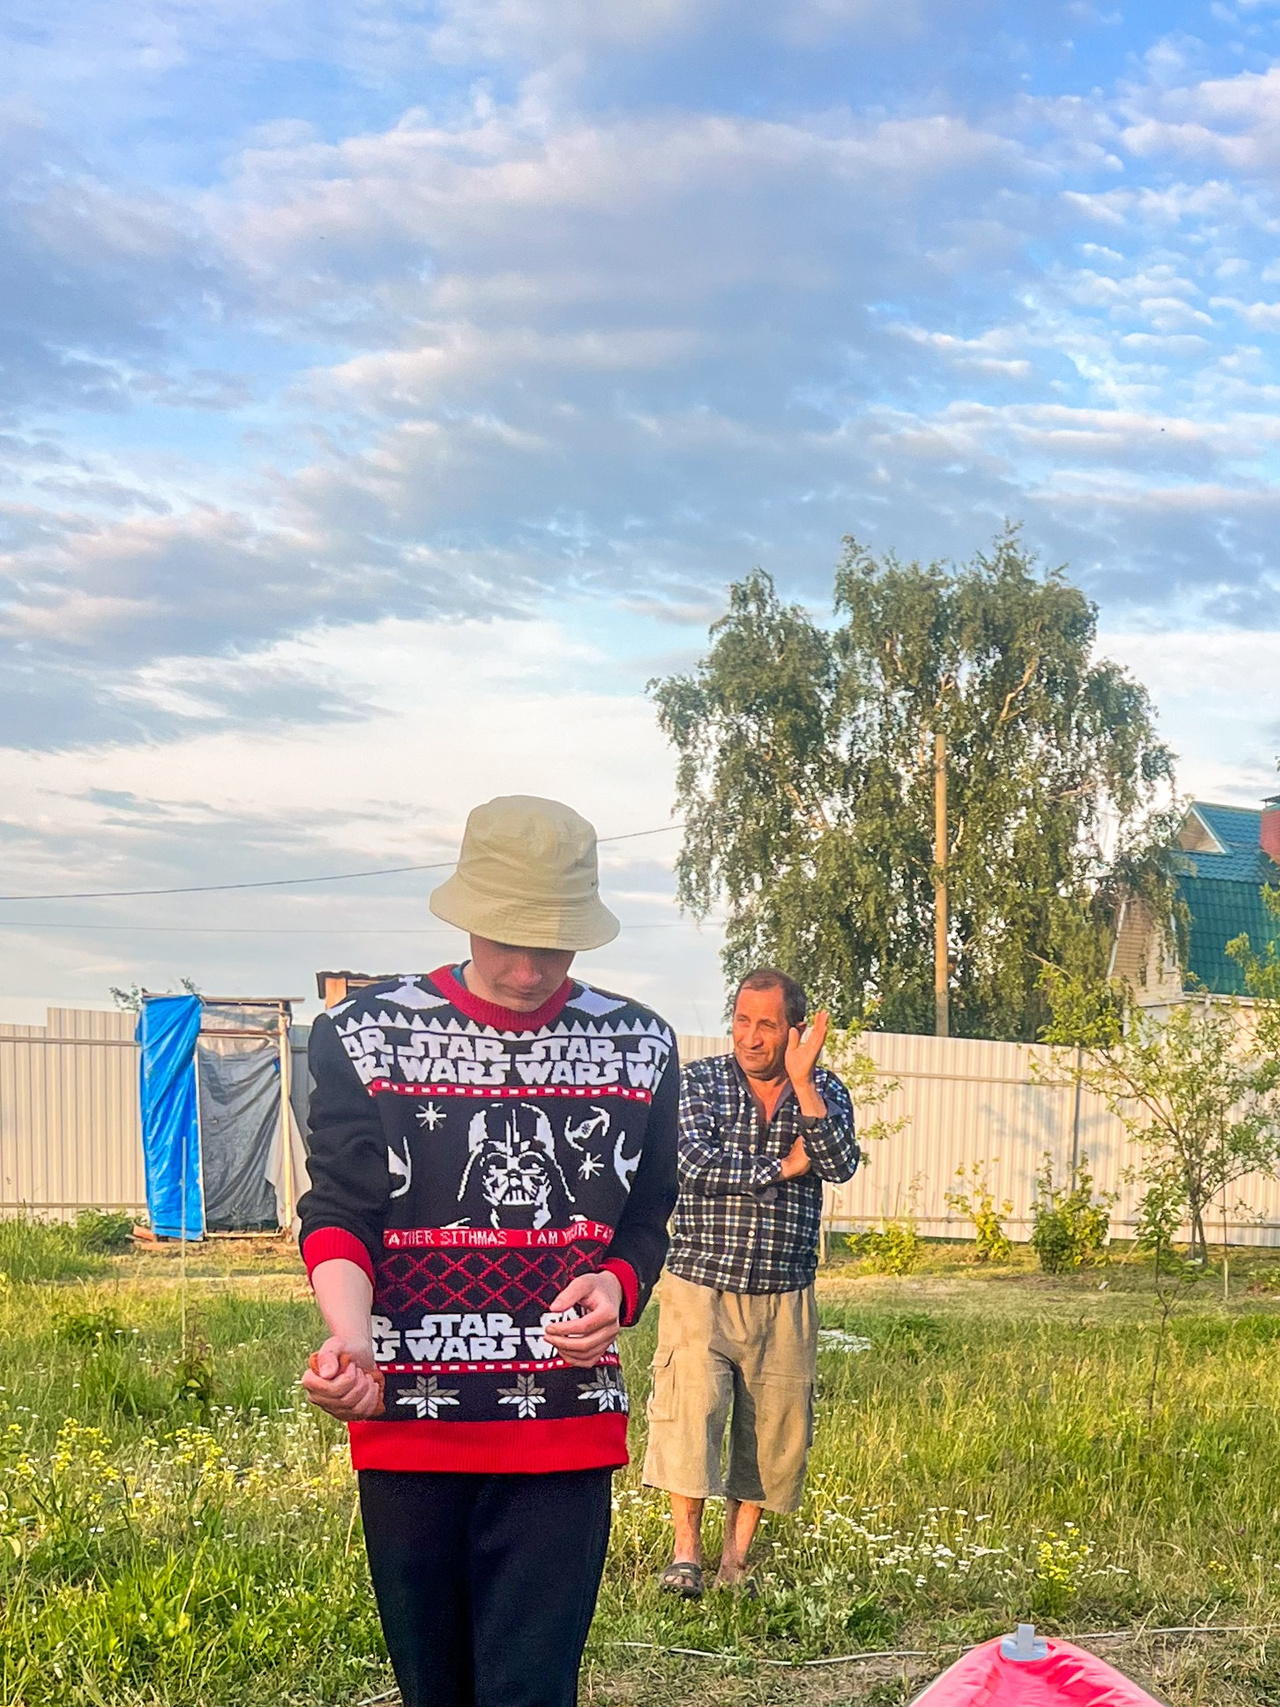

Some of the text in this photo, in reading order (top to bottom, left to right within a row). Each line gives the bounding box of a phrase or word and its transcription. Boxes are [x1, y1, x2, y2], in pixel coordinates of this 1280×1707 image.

[341, 1027, 395, 1060] AR
[397, 1032, 512, 1062] STAR
[515, 1036, 623, 1062] STAR
[398, 1055, 512, 1085] WARS
[515, 1060, 624, 1085] WARS
[526, 1230, 533, 1246] I
[537, 1230, 559, 1246] AM
[405, 1313, 521, 1338] STAR
[405, 1336, 521, 1362] WARS
